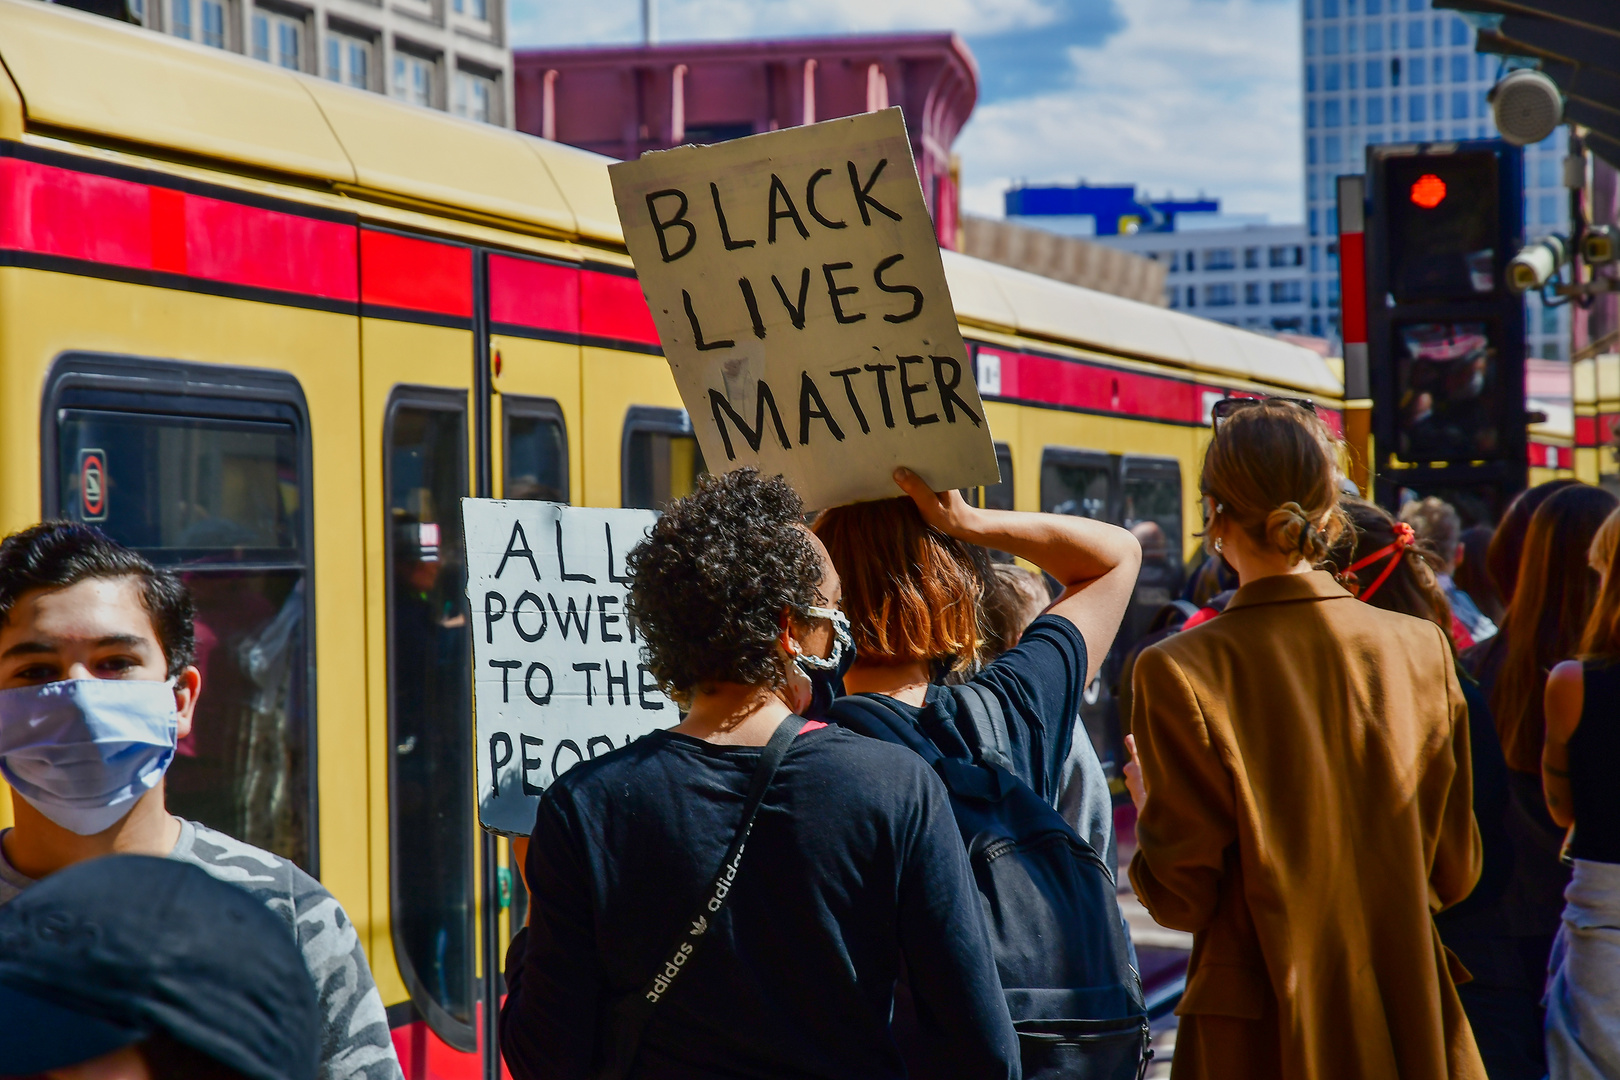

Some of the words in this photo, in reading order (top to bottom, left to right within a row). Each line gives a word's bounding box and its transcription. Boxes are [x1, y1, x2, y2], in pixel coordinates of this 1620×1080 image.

[645, 158, 902, 263] BLACK
[682, 254, 924, 351] LIVES
[708, 354, 982, 461] MATTER
[494, 519, 635, 584] ALL
[489, 659, 554, 706] TO
[572, 658, 664, 710] THE
[490, 731, 631, 798] PEO
[645, 942, 693, 1003] adidas
